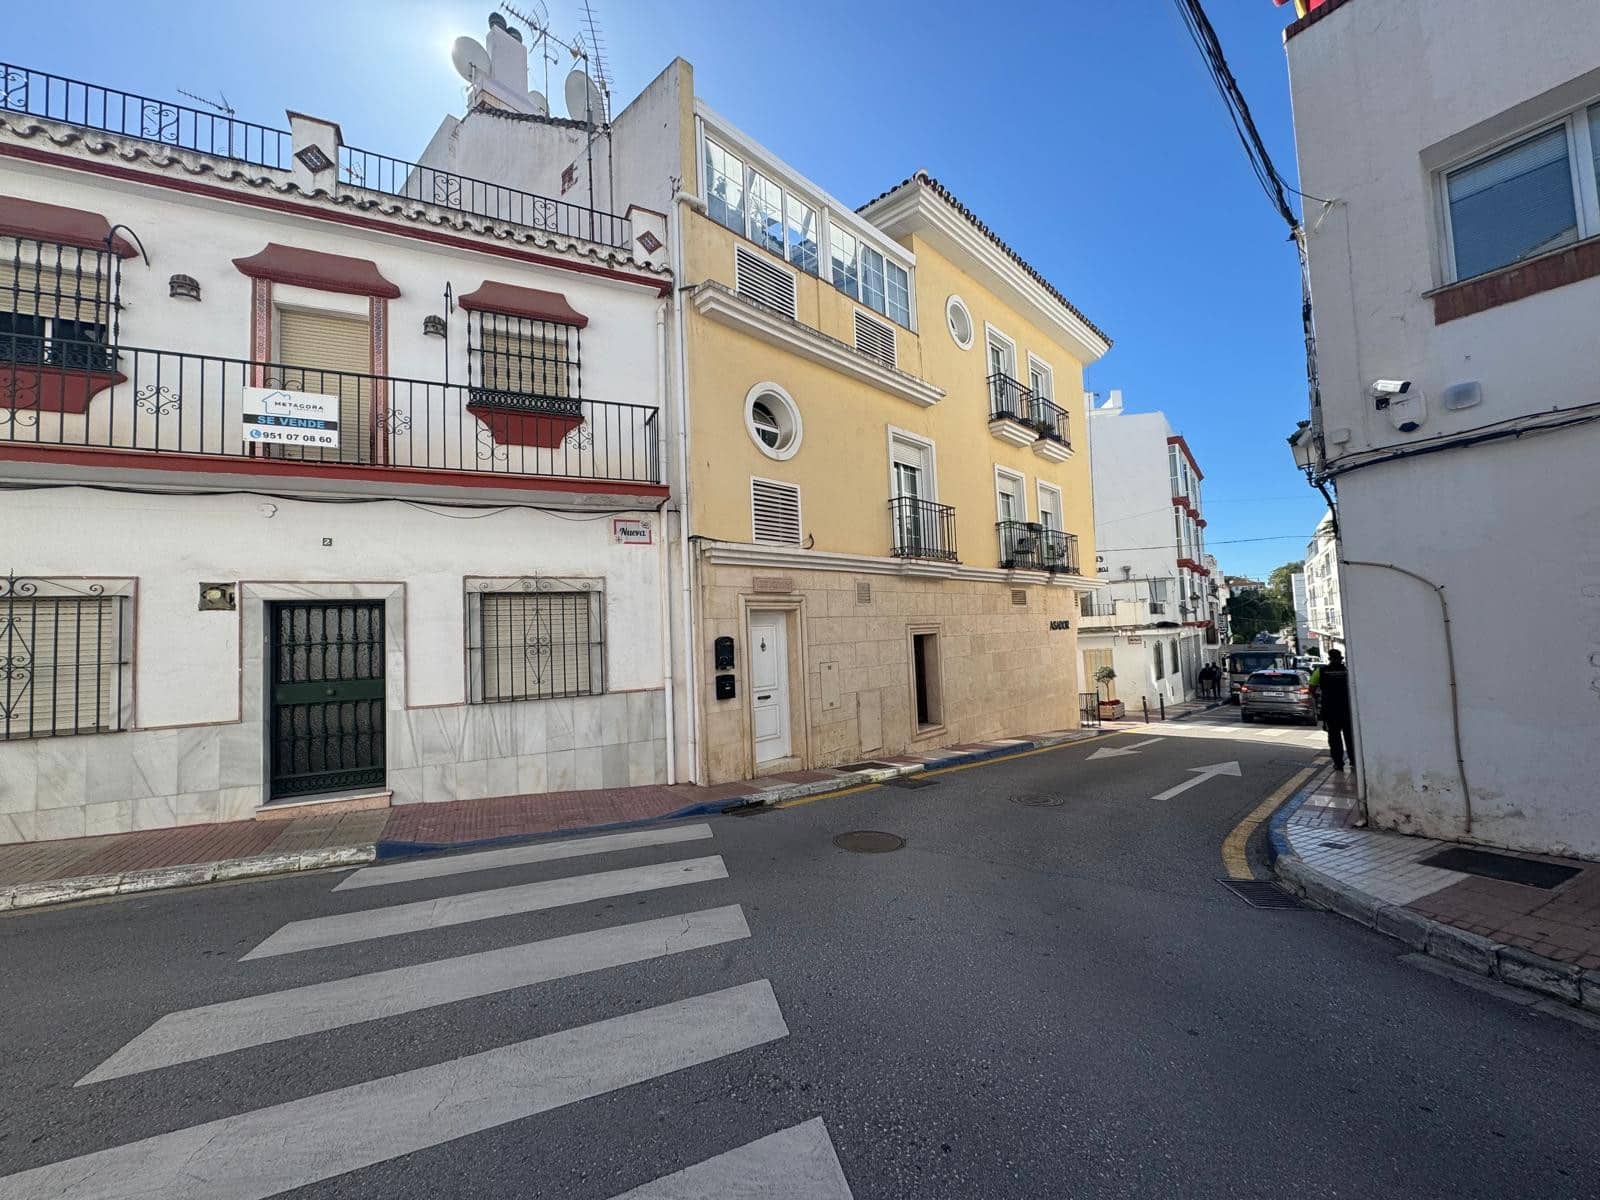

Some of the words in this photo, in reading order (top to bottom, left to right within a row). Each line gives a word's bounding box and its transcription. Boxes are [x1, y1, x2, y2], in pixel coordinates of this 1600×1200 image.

[274, 401, 324, 410] METAGORA
[257, 415, 275, 425] SE
[280, 418, 326, 429] VENDE
[263, 431, 282, 440] 951
[286, 433, 299, 441] 07
[319, 436, 332, 444] 60
[619, 527, 647, 537] Nueva
[1050, 620, 1070, 631] ASADOR
